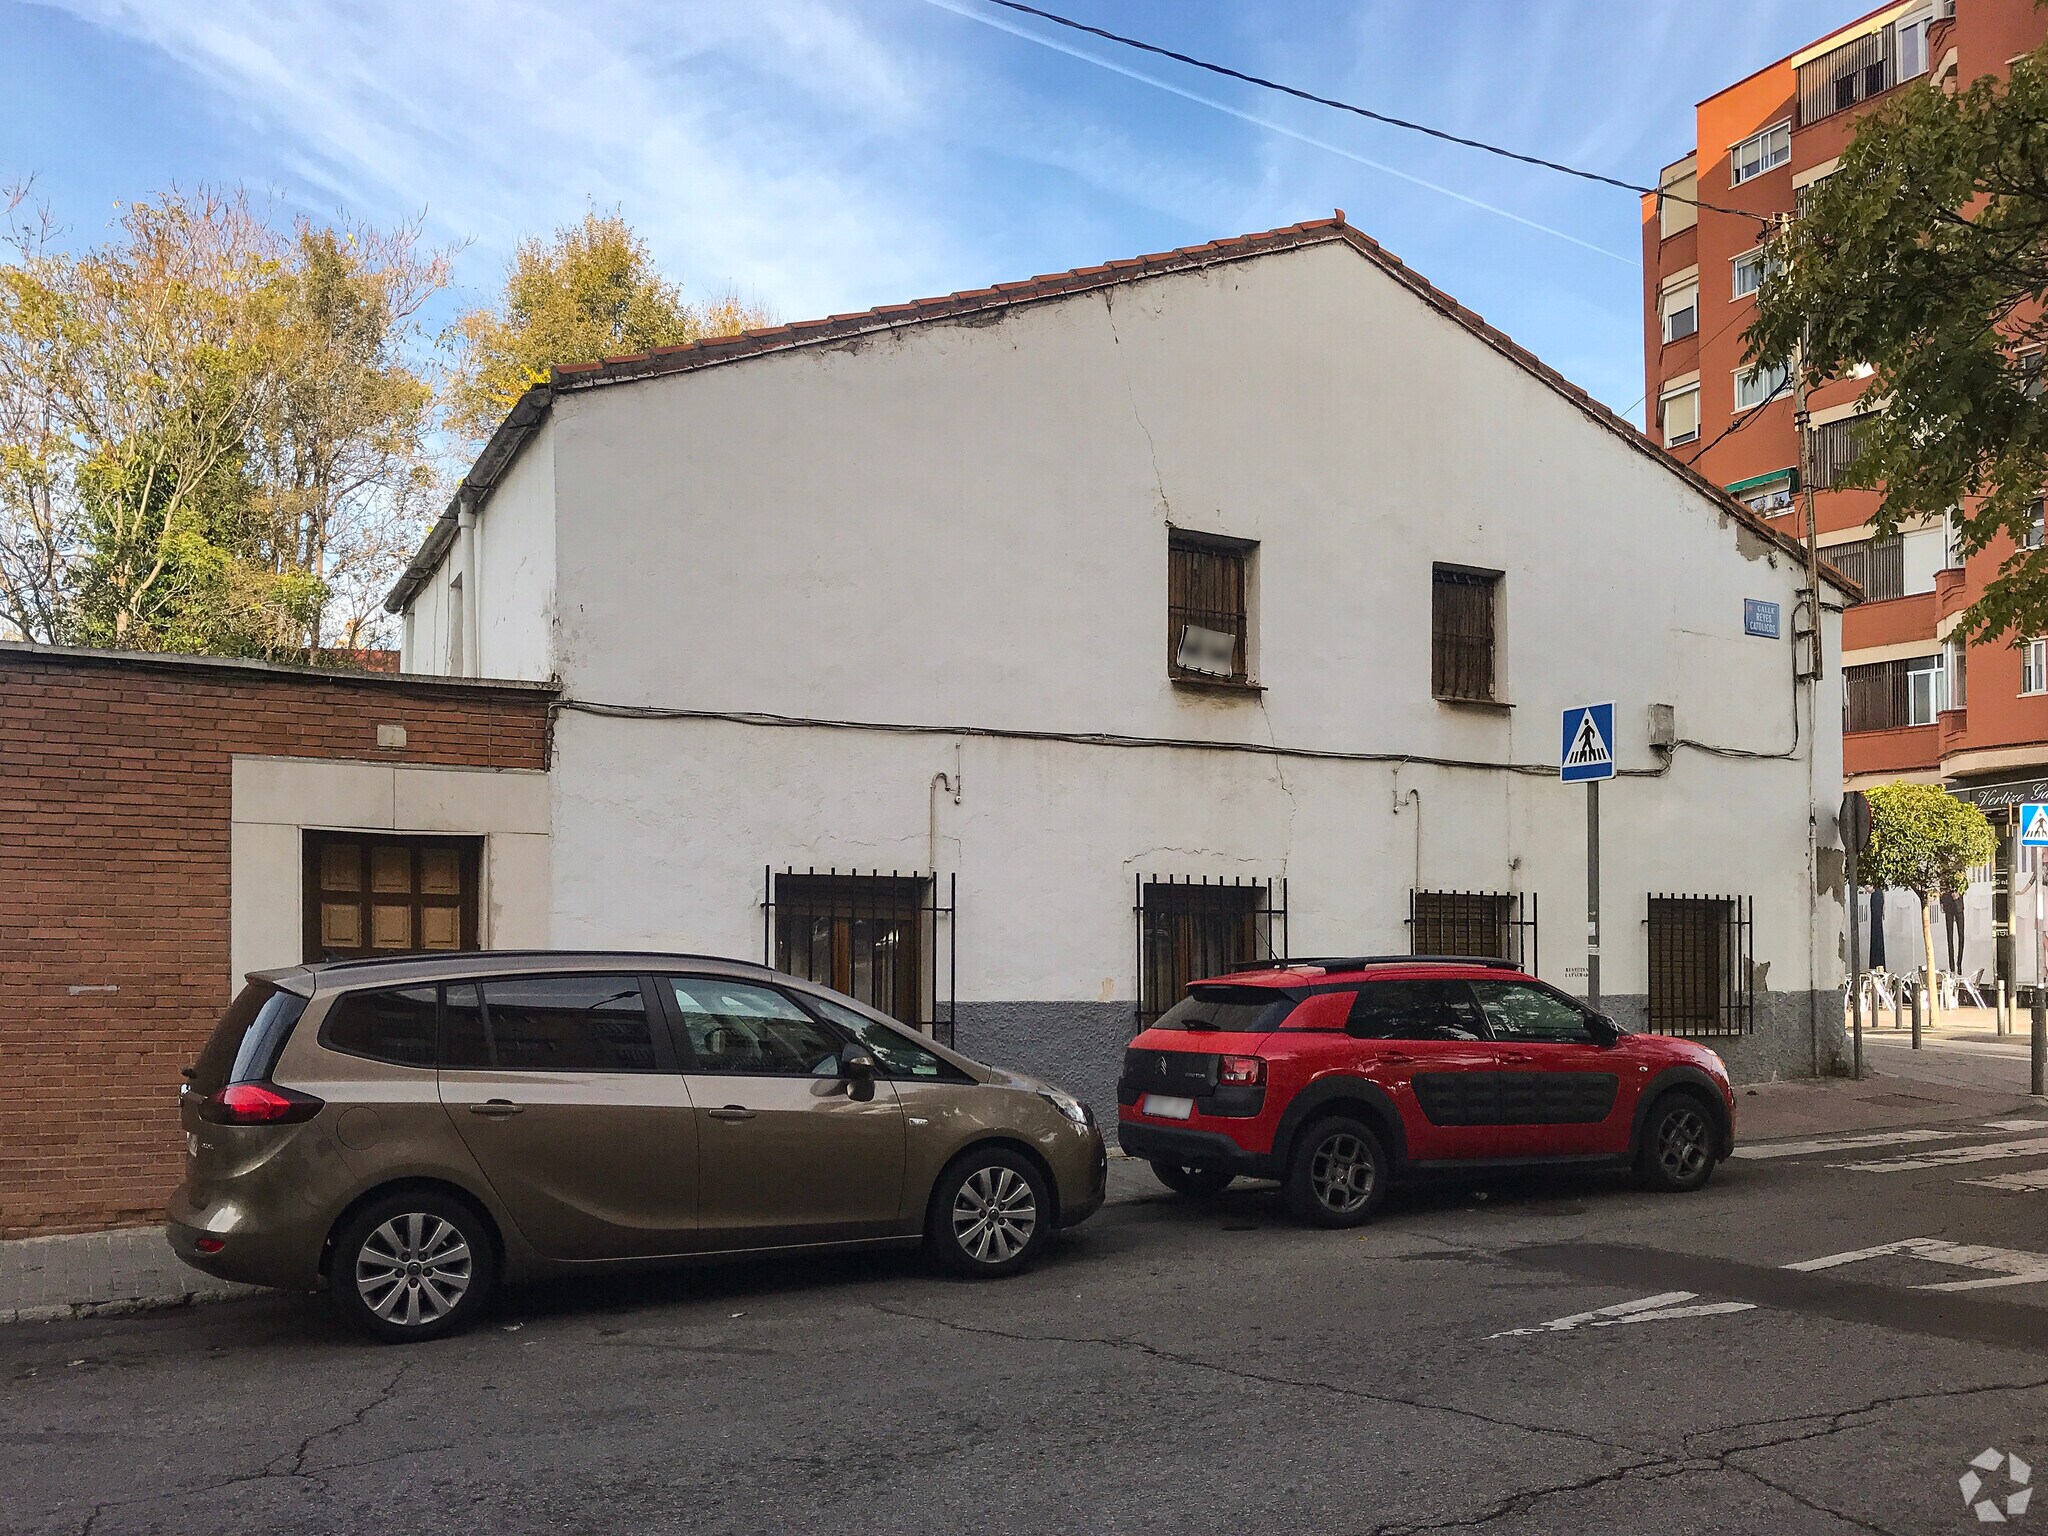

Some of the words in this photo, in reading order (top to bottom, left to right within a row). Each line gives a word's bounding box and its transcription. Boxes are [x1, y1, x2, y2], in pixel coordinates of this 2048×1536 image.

[1757, 605, 1775, 614] CALLE
[1756, 612, 1772, 623] REYES
[1978, 789, 2025, 807] Vertize
